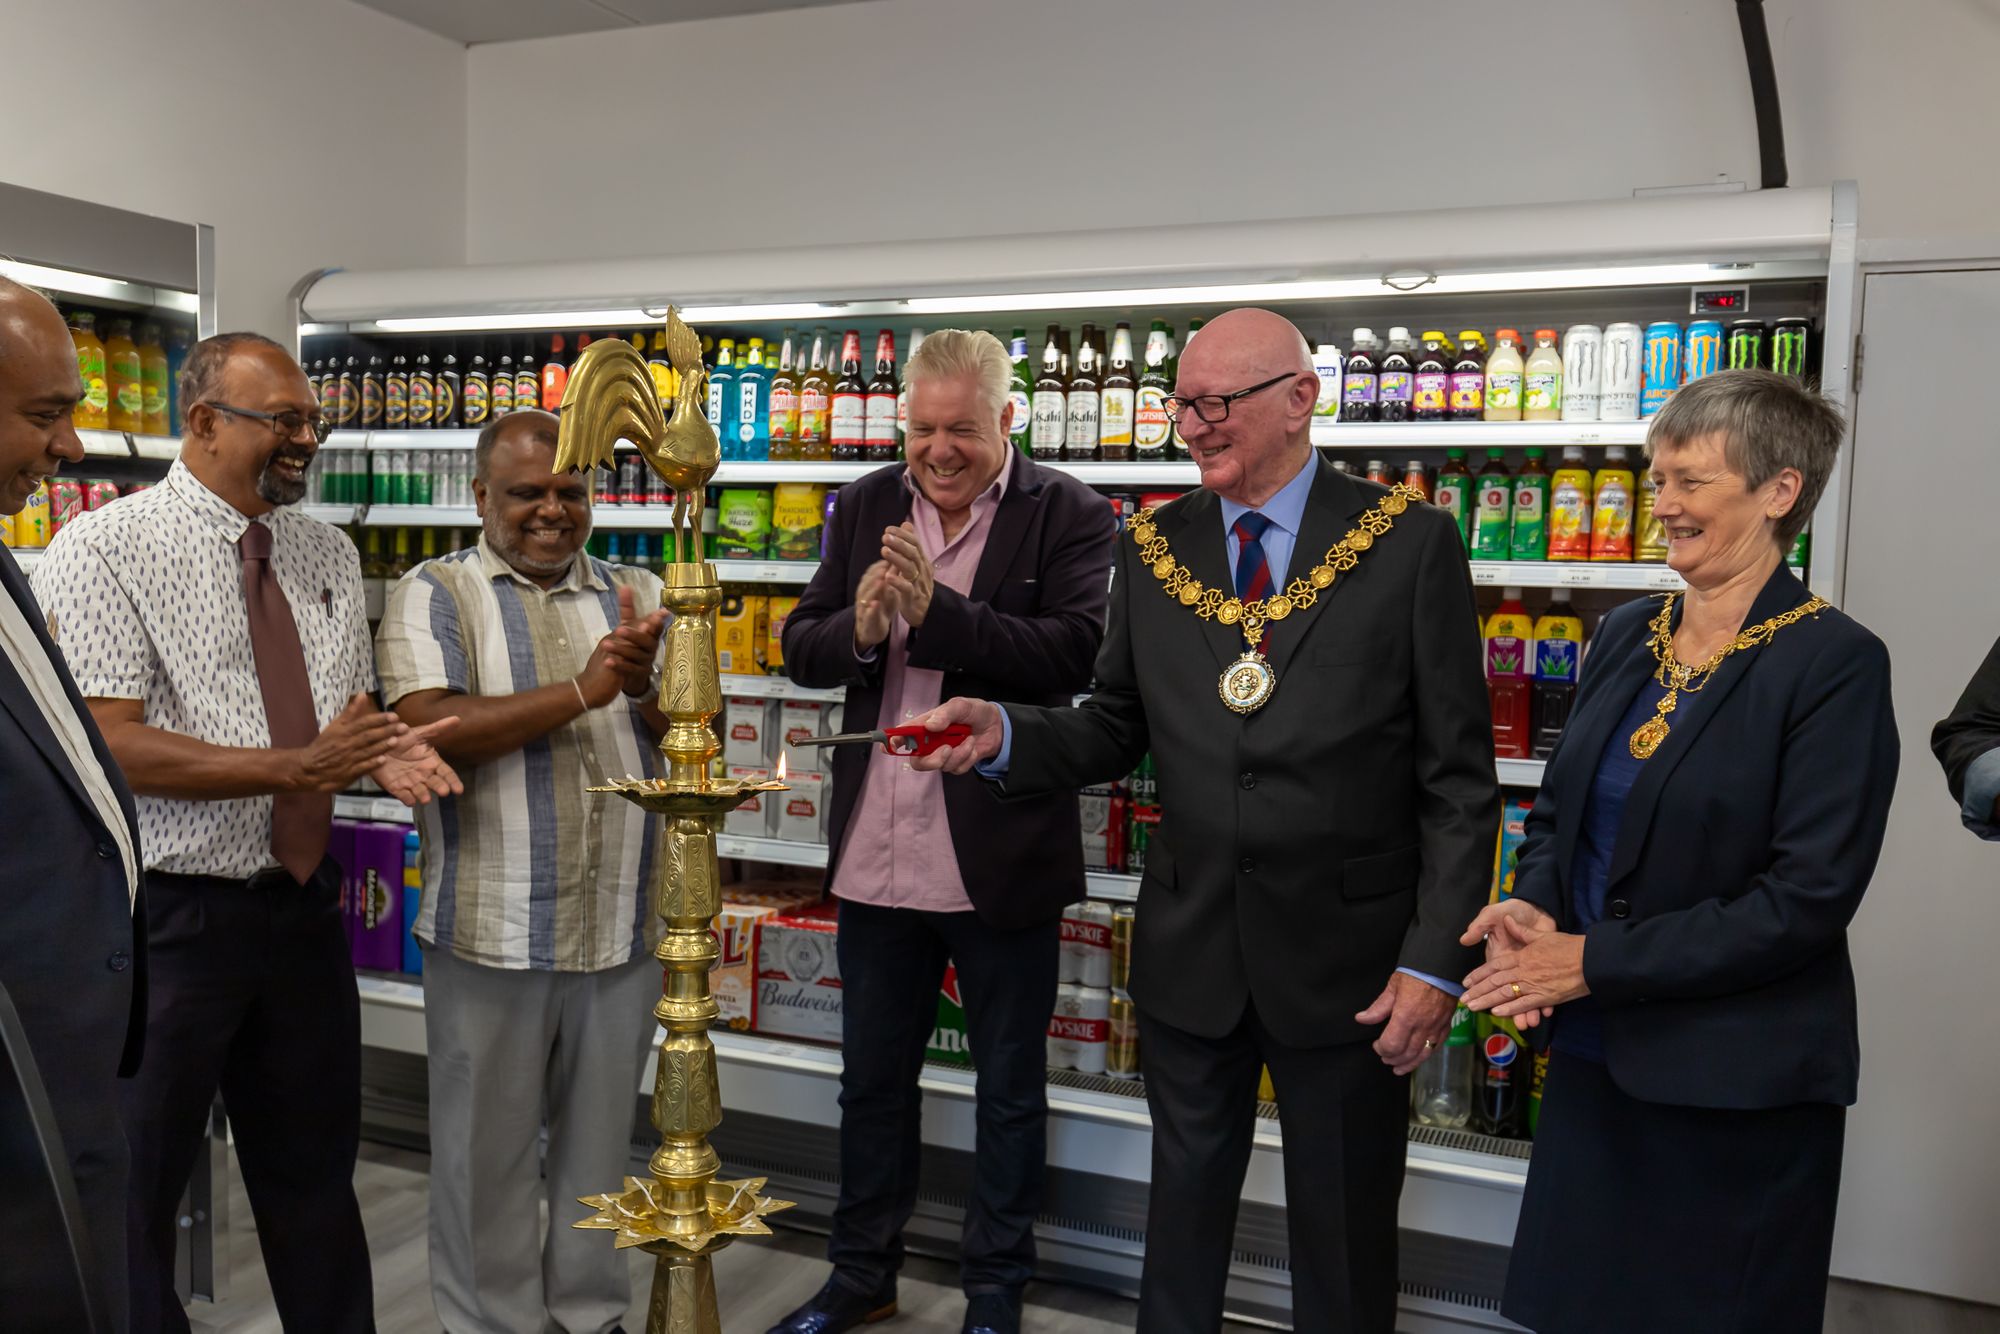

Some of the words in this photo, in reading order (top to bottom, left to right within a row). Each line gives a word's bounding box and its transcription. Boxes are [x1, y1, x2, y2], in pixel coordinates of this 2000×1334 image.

[711, 386, 719, 420] WKD
[743, 386, 753, 420] WKD
[728, 516, 754, 527] Haze
[1060, 922, 1105, 943] TYSKIE
